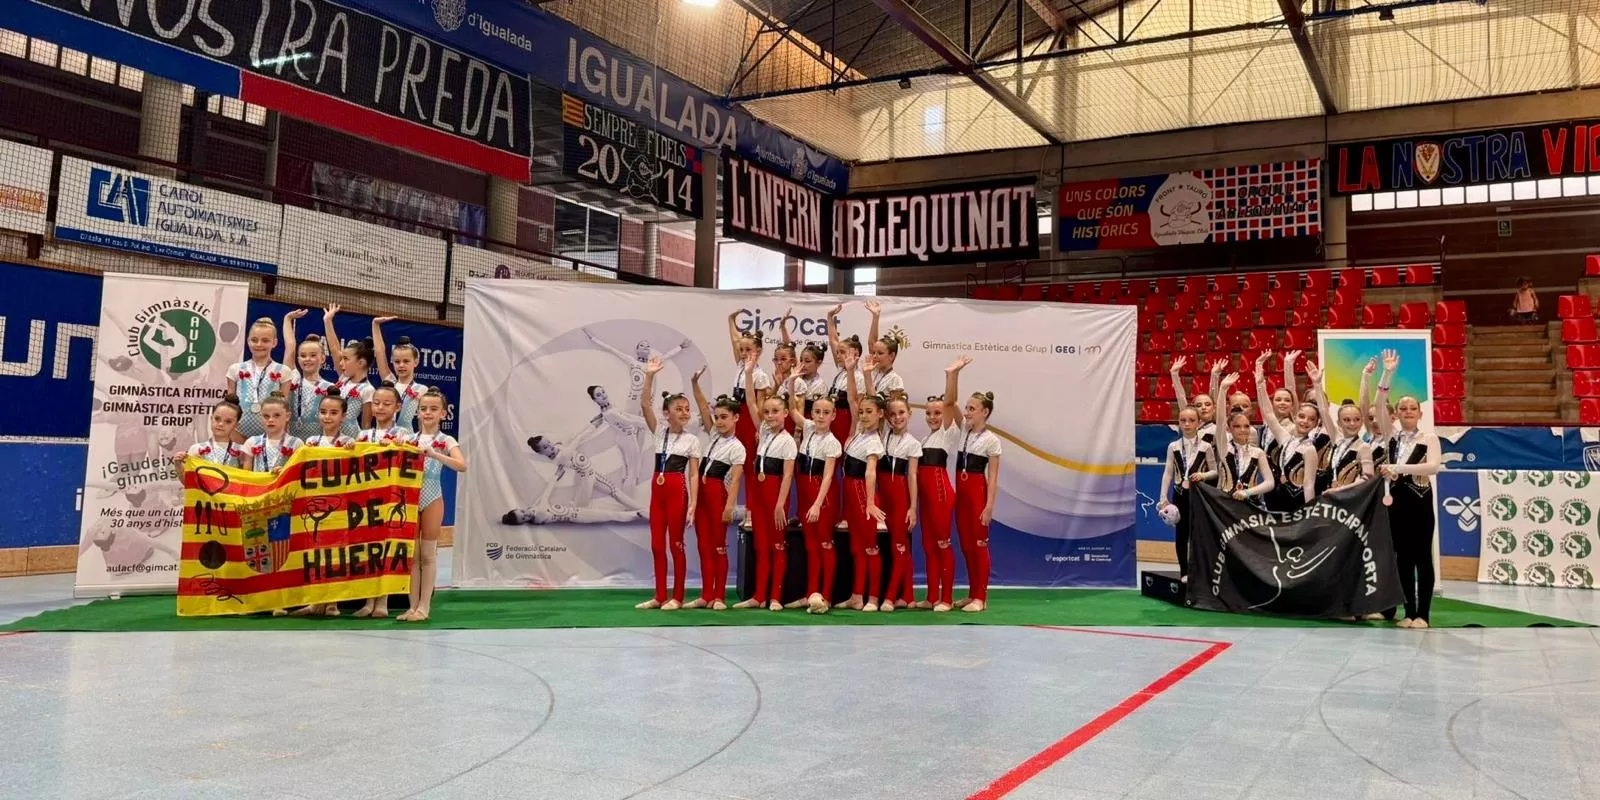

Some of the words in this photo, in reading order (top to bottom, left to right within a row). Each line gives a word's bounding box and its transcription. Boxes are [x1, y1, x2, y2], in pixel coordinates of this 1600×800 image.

[467, 13, 532, 52] d'Igualada
[375, 25, 514, 148] PREDA
[567, 37, 738, 151] IGUALADA
[583, 103, 637, 149] SEMPRE
[647, 130, 687, 168] FIDELS
[578, 134, 620, 185] 20
[663, 168, 693, 212] 14
[1337, 146, 1380, 192] LA
[159, 184, 204, 205] CAROL
[1066, 190, 1091, 202] UNS
[1095, 184, 1146, 201] COLORS
[1238, 183, 1293, 198] ORGULL
[157, 201, 259, 232] AUTOMATISMES
[729, 157, 822, 252] L'INFERN
[831, 185, 1035, 262] ARLEQUINAT
[1077, 208, 1102, 221] QUE
[1105, 202, 1133, 219] SÓN
[1072, 221, 1139, 239] HISTÒRICS
[134, 296, 211, 323] Gimnàstic
[127, 326, 141, 357] Club
[187, 316, 200, 367] AULA
[922, 340, 972, 351] Gimnàstica
[974, 342, 1009, 352] Estètica
[1012, 344, 1023, 353] de
[1025, 345, 1047, 354] Grup
[1055, 345, 1076, 354] GEG
[109, 383, 181, 398] GIMNÀSTICA
[183, 387, 229, 399] RÍTMICA
[103, 400, 175, 414] GIMNÀSTICA
[177, 402, 215, 415] ESTÈT
[144, 416, 158, 426] DE
[161, 416, 193, 427] GRUP
[117, 467, 178, 489] gimnàs
[300, 449, 420, 490] CUARTE
[100, 507, 122, 517] Més
[125, 510, 145, 519] que
[148, 509, 161, 517] un
[110, 518, 124, 528] 30
[127, 520, 151, 529] anys
[154, 518, 183, 528] d'hist
[347, 497, 385, 531] DE
[506, 544, 538, 552] Federació
[106, 563, 179, 573] aulacf@gimcat.
[1211, 553, 1226, 597] CLUB
